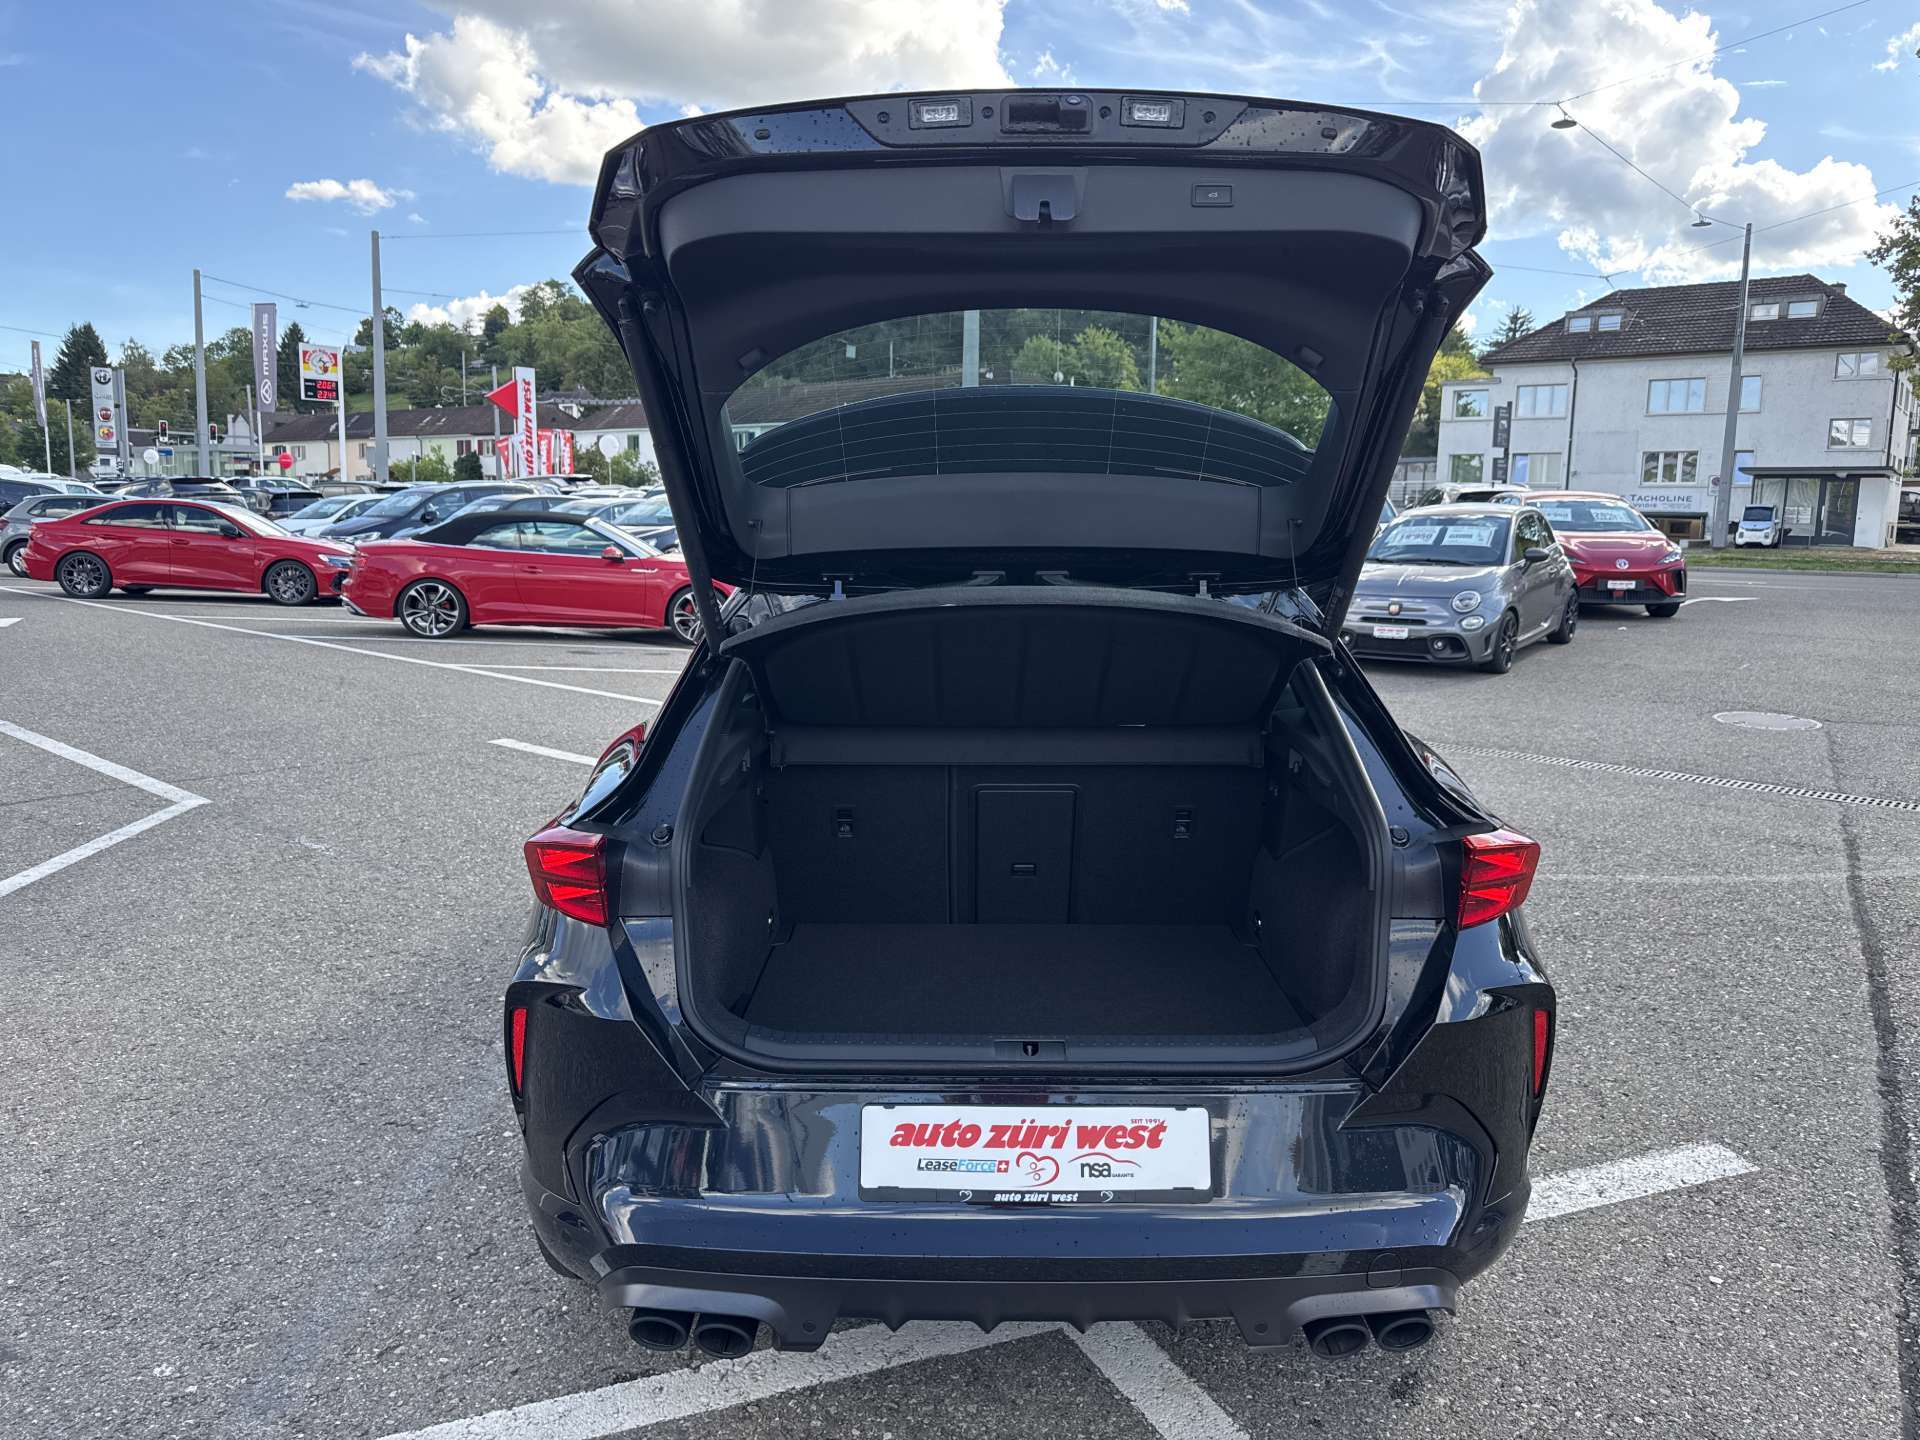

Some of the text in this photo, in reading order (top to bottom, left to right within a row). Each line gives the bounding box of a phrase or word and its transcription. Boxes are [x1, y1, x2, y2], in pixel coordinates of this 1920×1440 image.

[262, 313, 270, 376] MAXUS
[522, 378, 532, 414] west
[1630, 494, 1693, 503] TACHOLINE
[889, 1118, 1168, 1149] auto züri west
[917, 1158, 996, 1172] LeaseForce
[1080, 1162, 1111, 1178] nsa
[993, 1191, 1079, 1202] auto züri west
